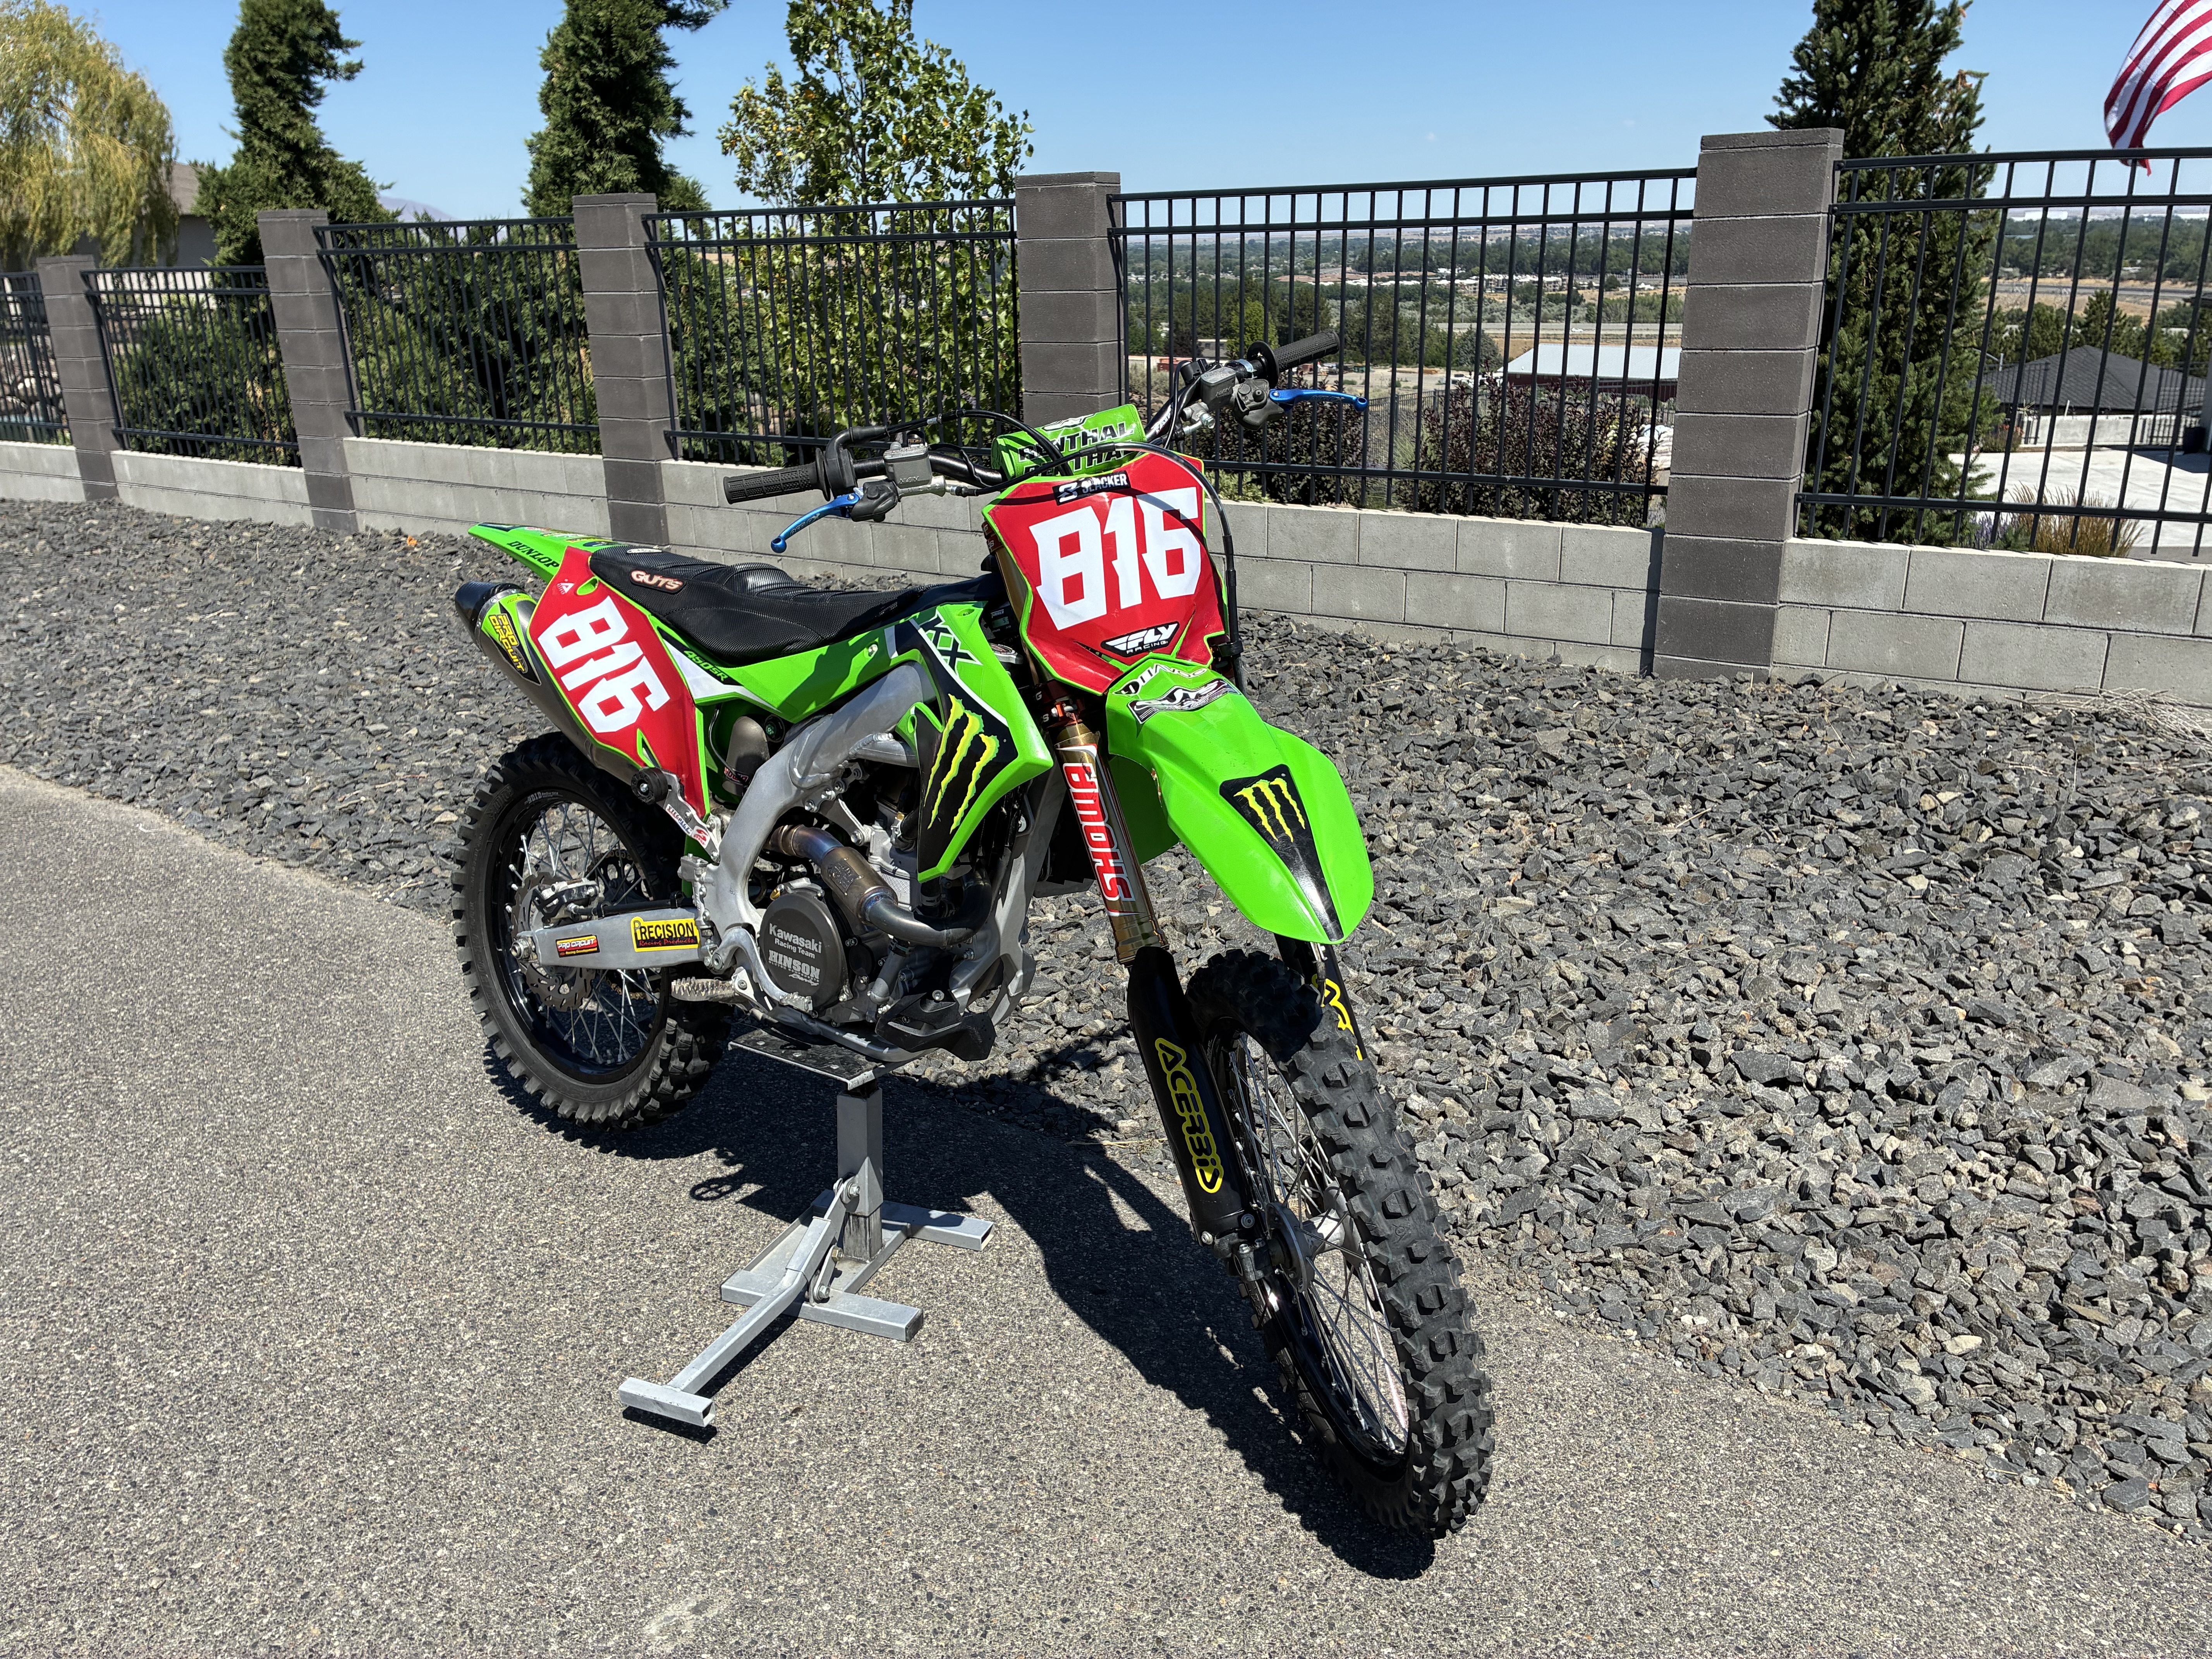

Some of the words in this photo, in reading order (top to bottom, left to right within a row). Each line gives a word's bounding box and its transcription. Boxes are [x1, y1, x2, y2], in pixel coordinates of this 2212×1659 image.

[507, 541, 560, 568] DUNLOP
[1029, 487, 1201, 631] 816
[631, 570, 684, 591] GUTS
[489, 615, 525, 673] CIRCUIT
[498, 615, 519, 646] PRO
[921, 608, 982, 676] KX
[1106, 622, 1178, 651] FLY
[1126, 640, 1166, 655] RACING
[538, 596, 670, 733] 816
[684, 650, 728, 681] 450SR
[571, 938, 595, 948] CIRCUIT
[633, 920, 695, 945] PRECISION
[769, 923, 822, 953] Kawasaki
[775, 938, 797, 953] Racing
[798, 946, 815, 959] Team
[768, 950, 820, 979] HINSON
